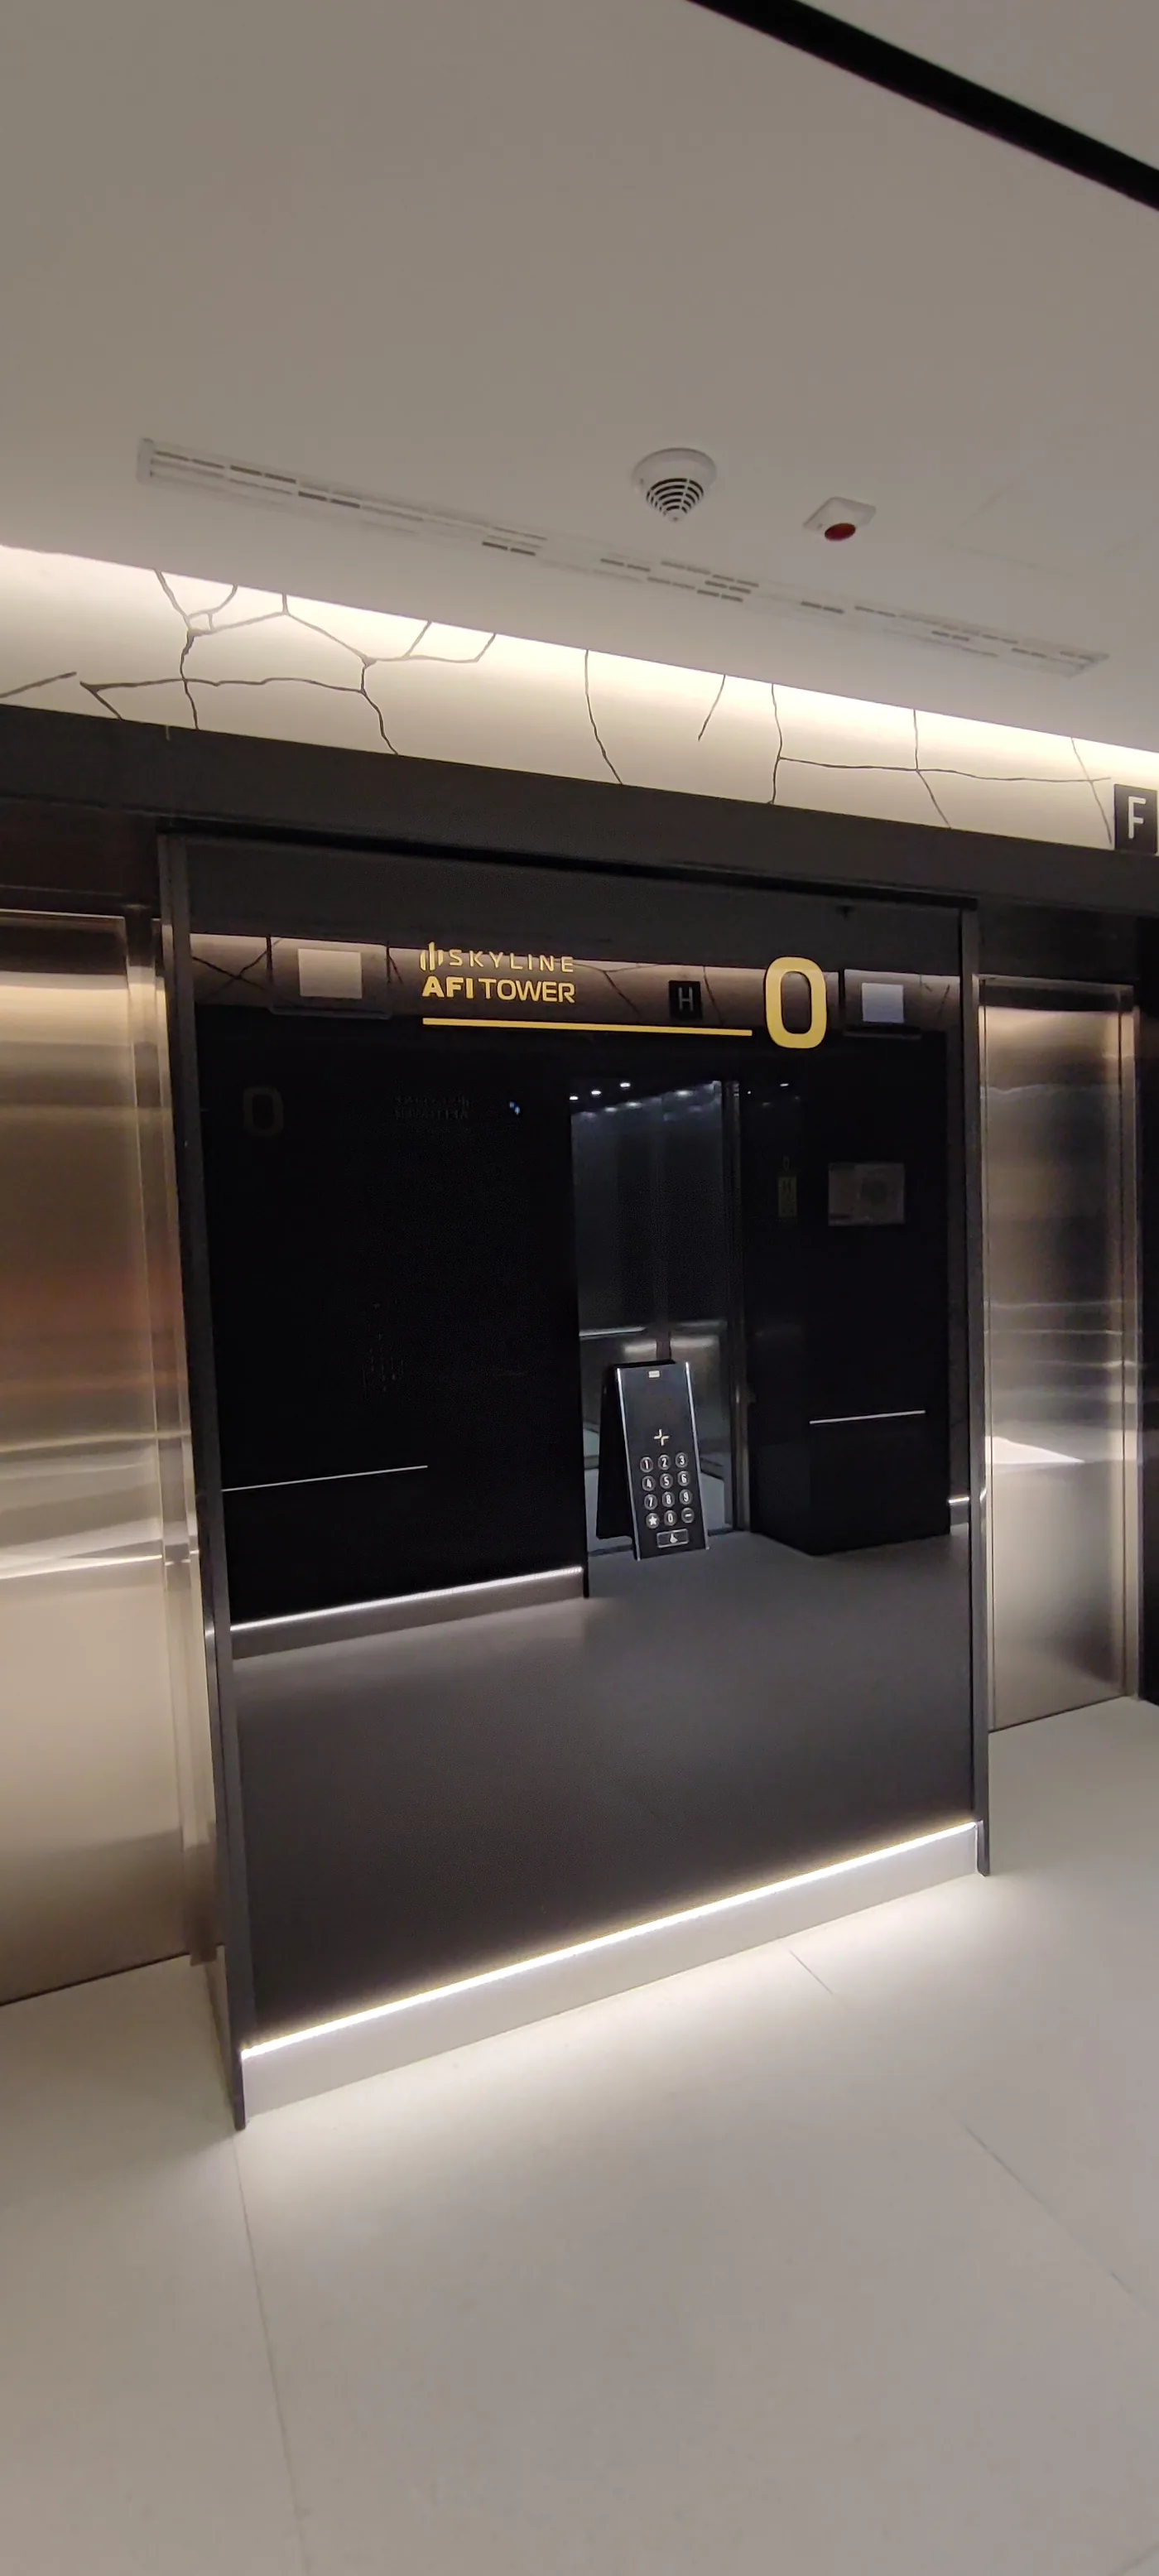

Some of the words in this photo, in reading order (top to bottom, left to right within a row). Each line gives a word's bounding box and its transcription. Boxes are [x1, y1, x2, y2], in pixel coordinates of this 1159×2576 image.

[1128, 796, 1147, 840] F
[449, 949, 574, 973] SKYLINE
[422, 975, 474, 999] AFI
[478, 978, 575, 1004] TOWER
